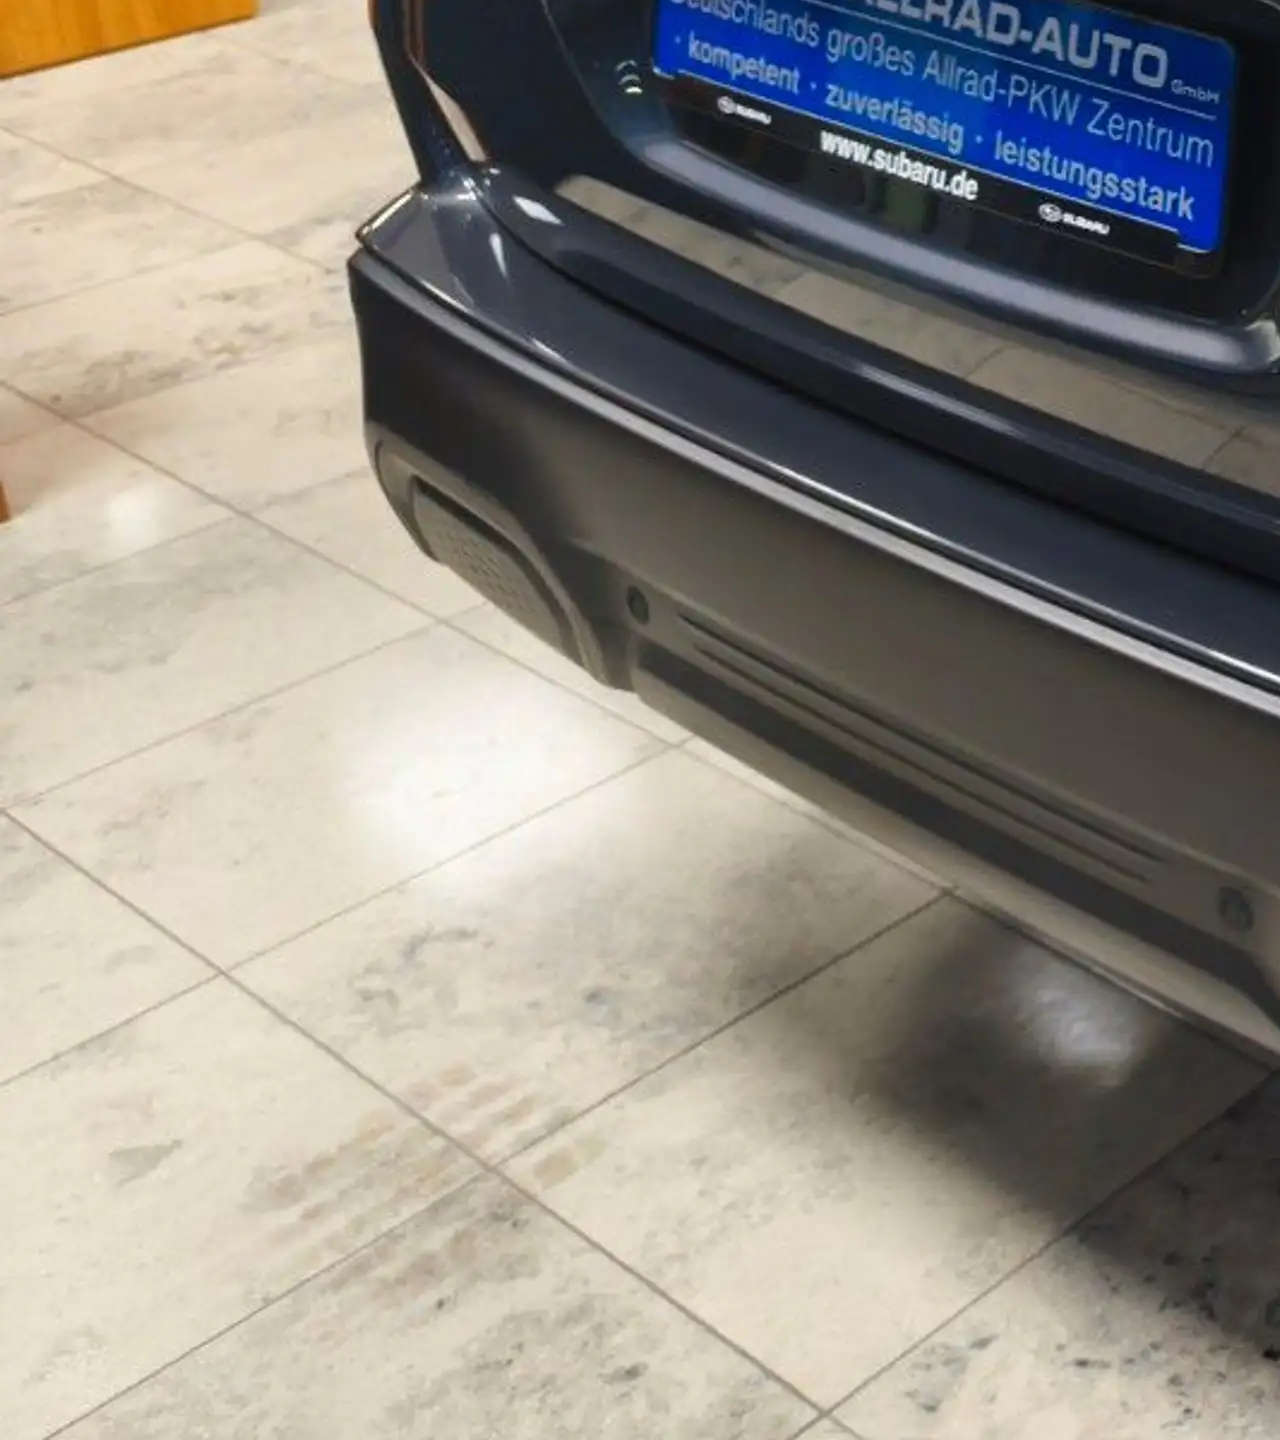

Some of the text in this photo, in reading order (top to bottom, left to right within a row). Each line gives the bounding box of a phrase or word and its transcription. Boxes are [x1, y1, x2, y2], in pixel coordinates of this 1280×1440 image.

[688, 29, 1195, 222] kompetent zuverlässig leistungsstark
[826, 27, 917, 78] großes
[922, 48, 1082, 127] Allrad-PKW
[1086, 97, 1214, 168] Zentrum
[1171, 78, 1221, 106] GmbH
[819, 129, 979, 201] www.subaru.de
